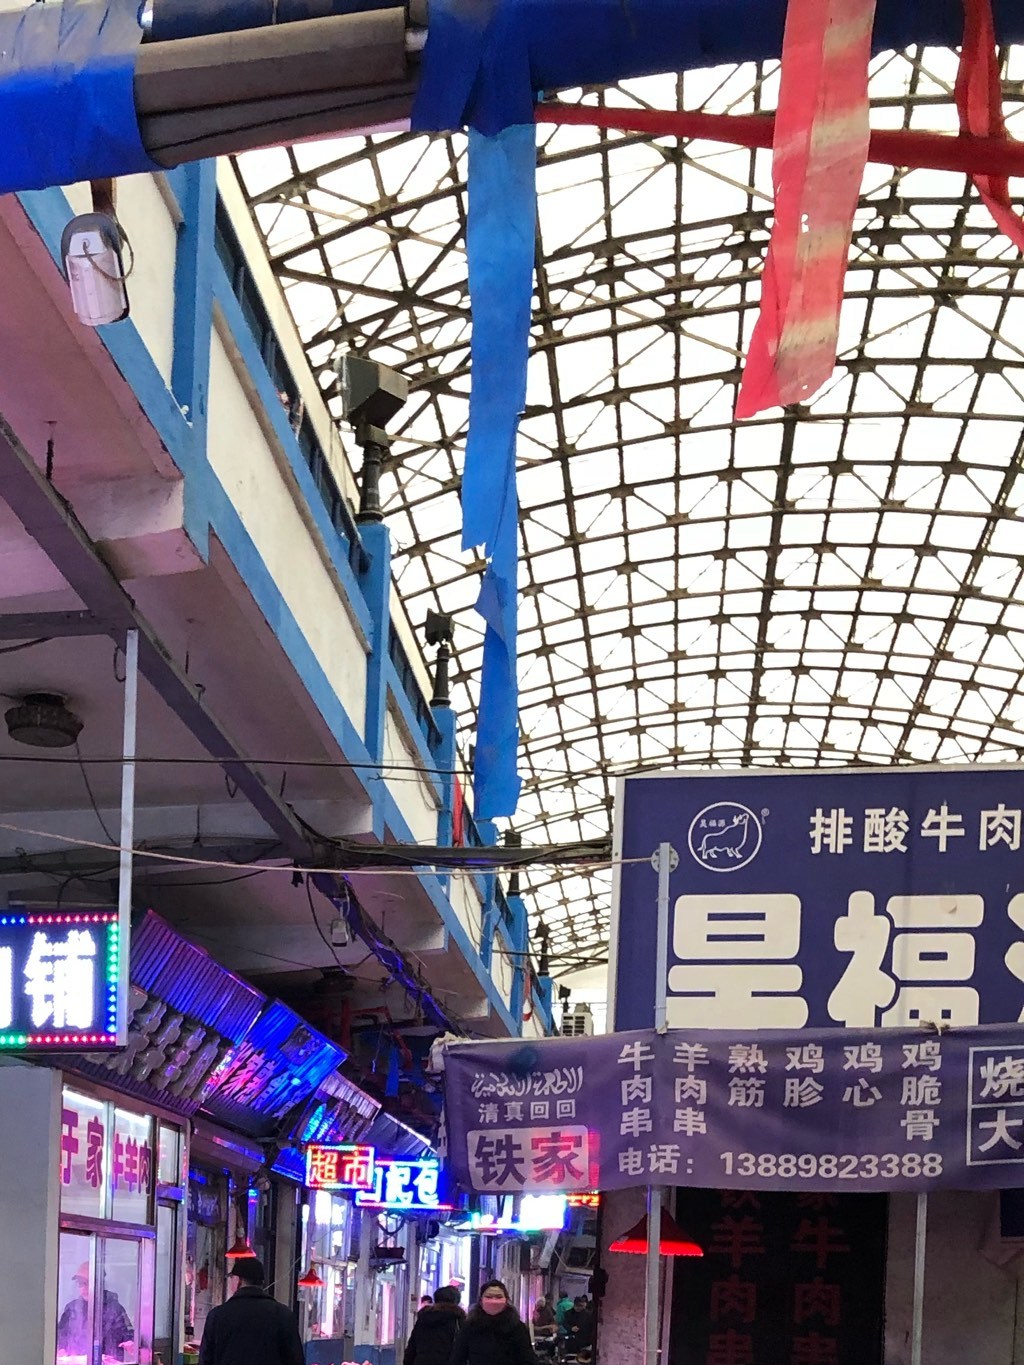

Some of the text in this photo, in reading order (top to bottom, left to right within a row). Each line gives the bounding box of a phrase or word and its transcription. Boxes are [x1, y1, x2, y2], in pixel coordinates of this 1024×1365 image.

[809, 803, 1023, 854] 排酸牛肉
[617, 1041, 655, 1137] 牛肉串
[673, 1042, 709, 1137] 羊肉串
[727, 1044, 768, 1108] 熟筋
[783, 1043, 825, 1108] 鸡胗
[842, 1042, 883, 1107] 鸡心
[900, 1040, 942, 1141] 鸡脆骨
[478, 1099, 576, 1123] 清真回回
[978, 1109, 1023, 1153] 大
[310, 1151, 370, 1187] 超市
[475, 1132, 584, 1186] 铁家
[720, 1152, 943, 1178] 13889823388
